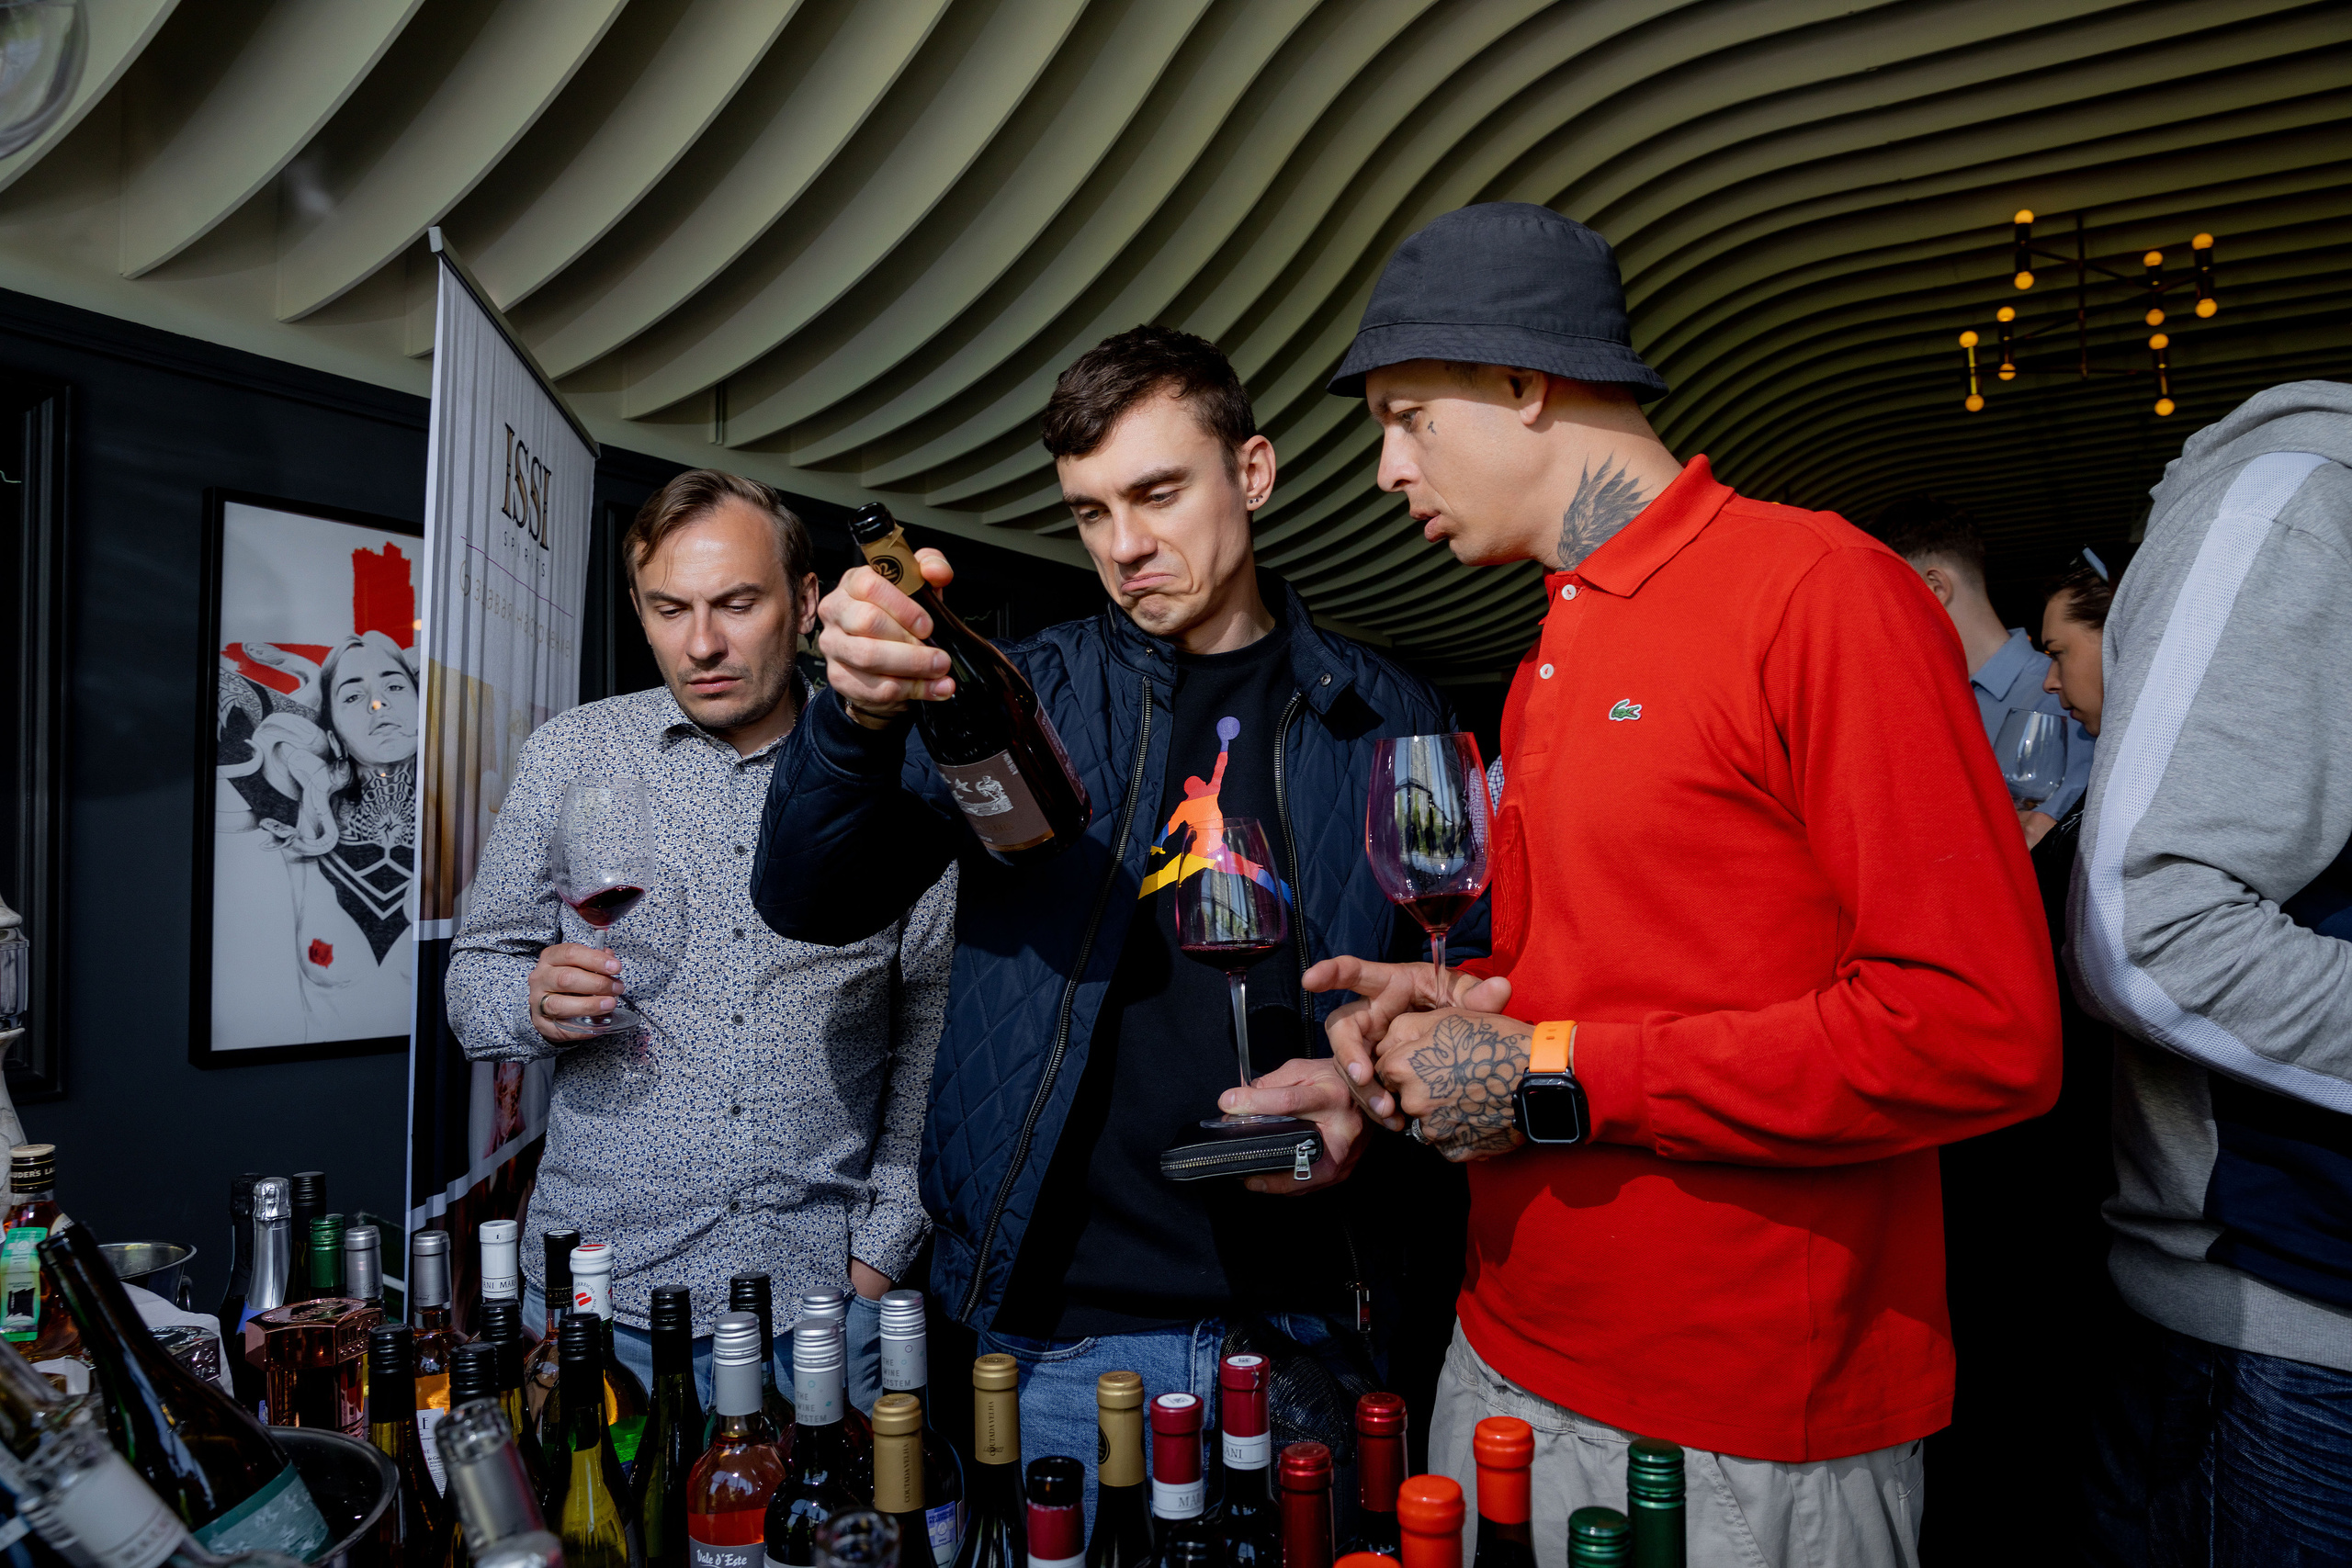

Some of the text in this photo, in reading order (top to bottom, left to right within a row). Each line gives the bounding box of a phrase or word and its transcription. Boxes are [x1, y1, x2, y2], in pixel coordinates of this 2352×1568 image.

[502, 423, 551, 551] ISSI
[503, 531, 546, 578] SPIRITS
[883, 1357, 894, 1366] THE
[883, 1368, 900, 1377] WINE
[883, 1377, 911, 1387] SYSTEM
[797, 1391, 808, 1401] THE
[797, 1403, 816, 1412] WINE
[797, 1413, 827, 1423] SYSTEM
[987, 1401, 996, 1457] COUTADA VELHA
[715, 1552, 748, 1567] d'Este
